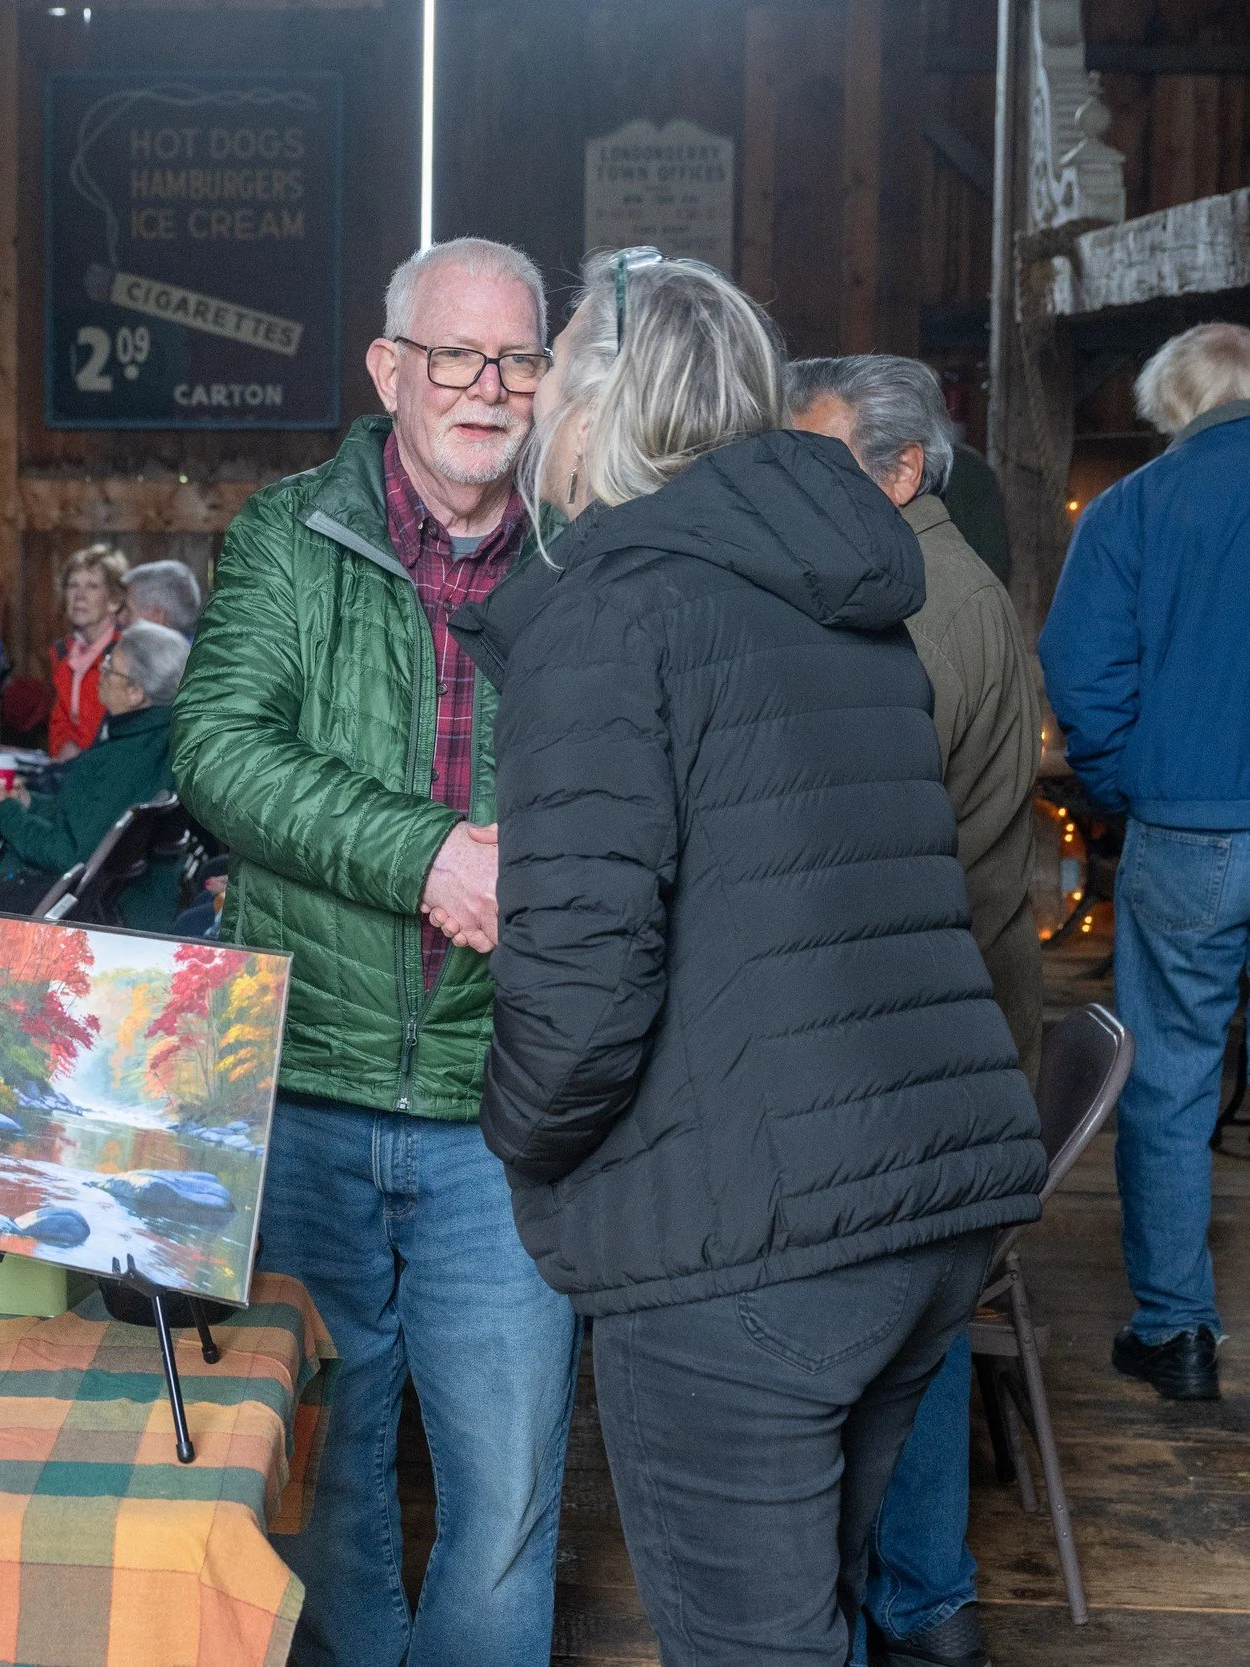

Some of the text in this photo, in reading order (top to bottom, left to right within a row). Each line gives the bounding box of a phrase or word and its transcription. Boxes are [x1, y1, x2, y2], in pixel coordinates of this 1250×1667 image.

[131, 128, 303, 160] HOT DOGS
[131, 170, 303, 199] HAMBURGERS
[129, 210, 305, 240] ICE CREAM
[125, 281, 295, 349] CIGARETTES
[174, 384, 283, 406] CARTON
